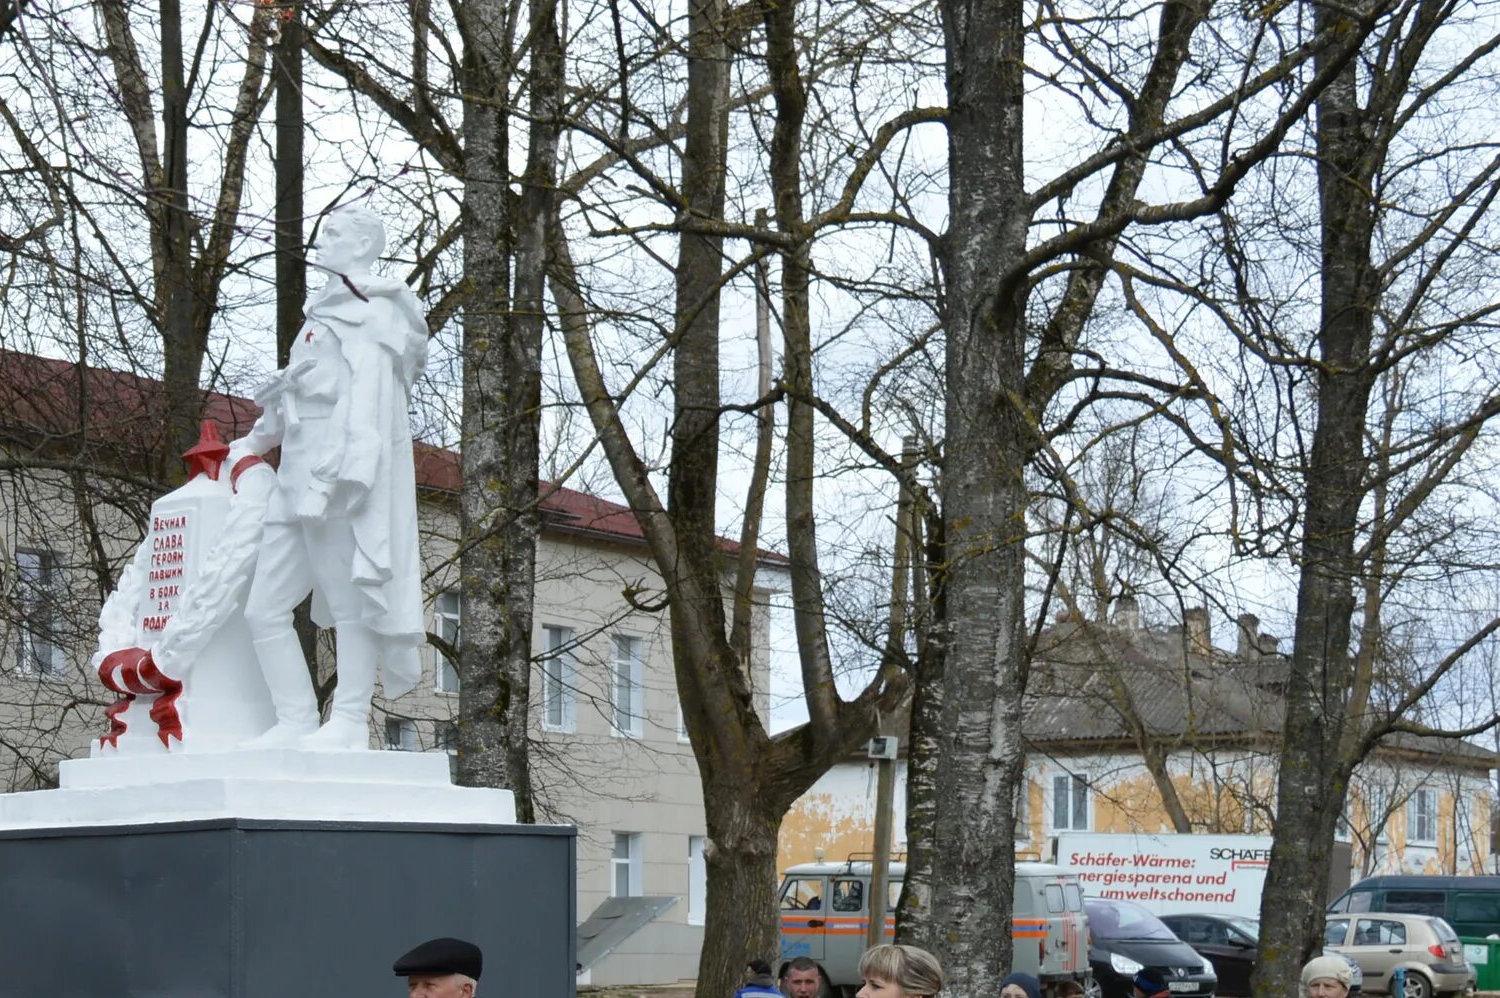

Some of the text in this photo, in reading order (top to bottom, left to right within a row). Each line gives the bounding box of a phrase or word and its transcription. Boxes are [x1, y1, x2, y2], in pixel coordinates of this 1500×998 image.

[153, 534, 183, 551] СЛАВА
[150, 585, 179, 599] В БОЯХ
[1070, 852, 1196, 868] Schäfer-Wärme:
[1210, 847, 1271, 861] SCHÄFE
[1196, 871, 1227, 885] und
[1100, 887, 1236, 903] umweltschonend
